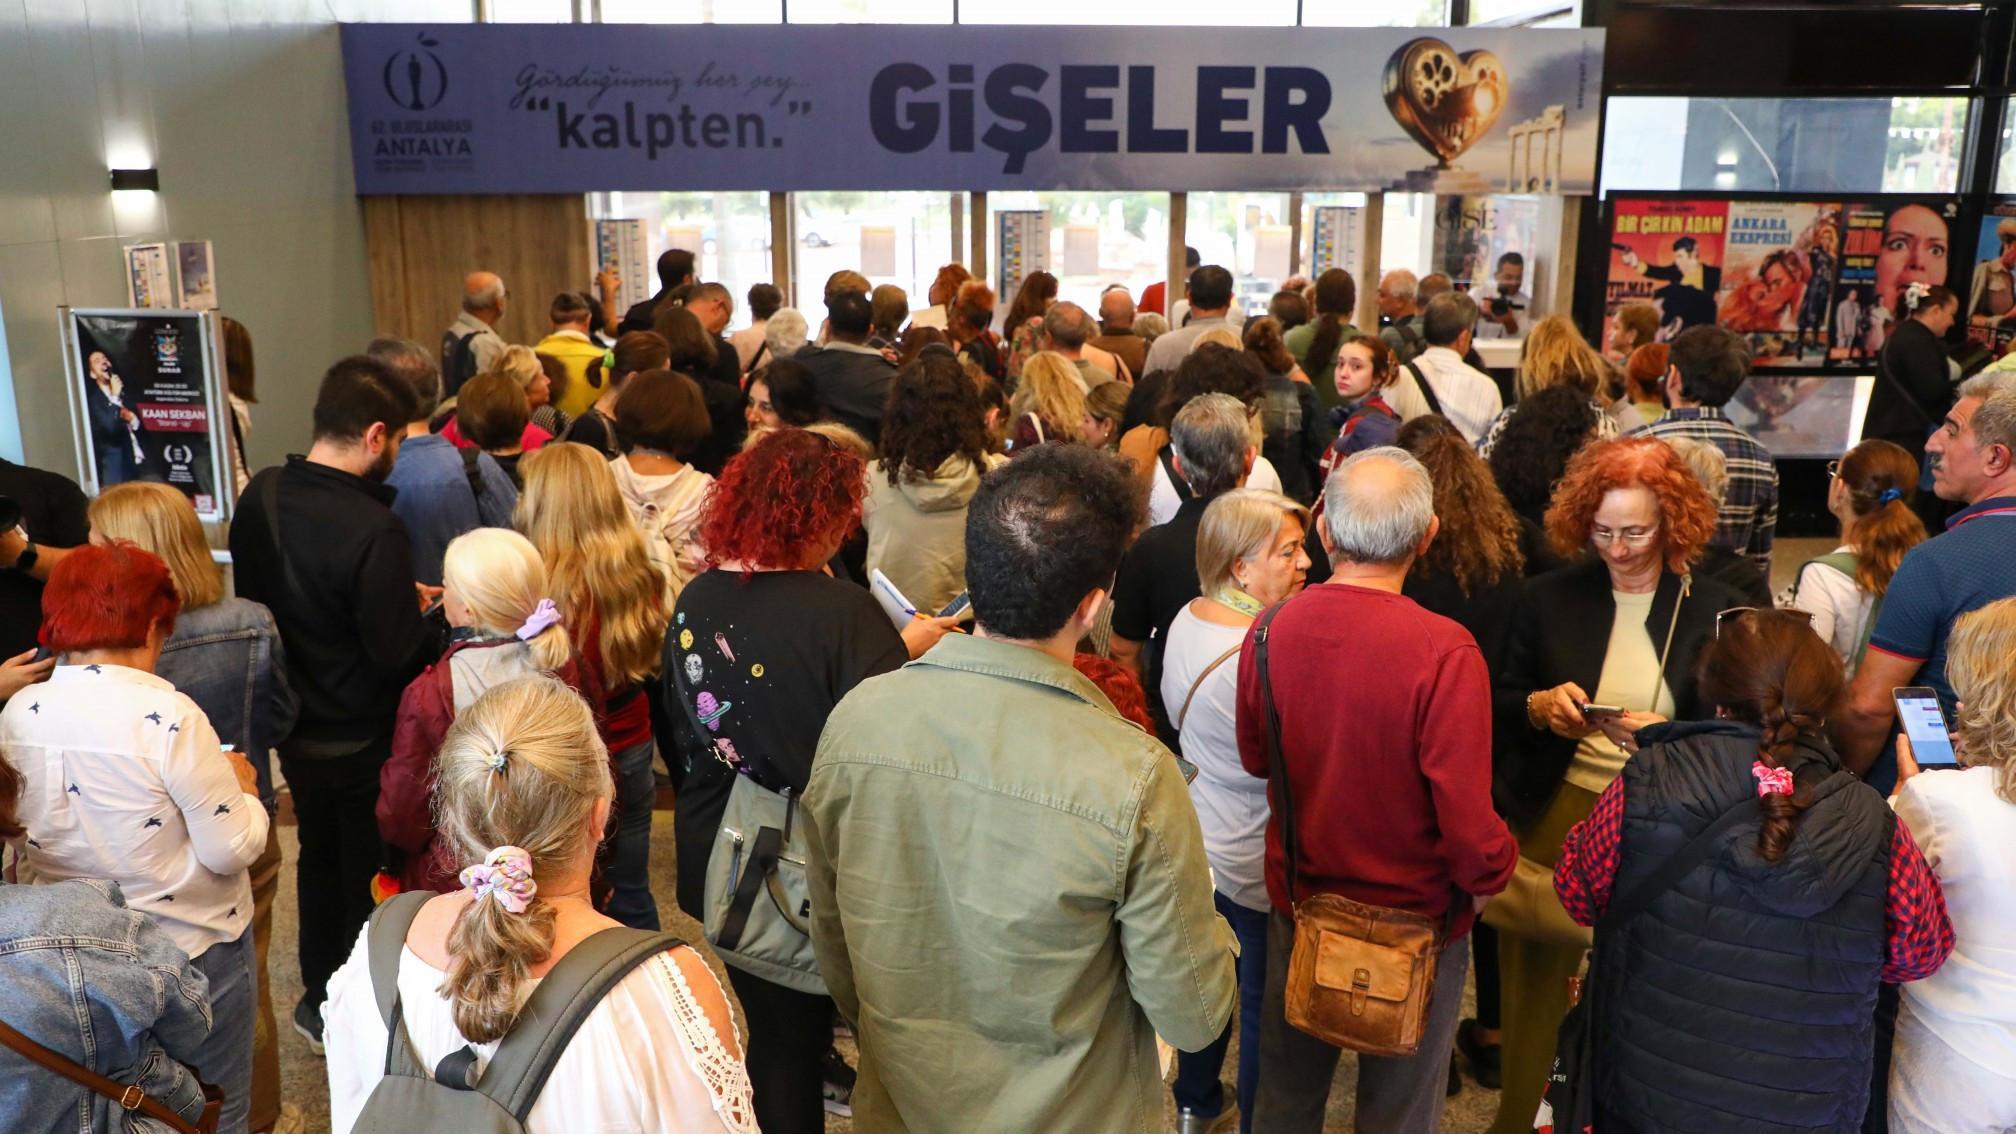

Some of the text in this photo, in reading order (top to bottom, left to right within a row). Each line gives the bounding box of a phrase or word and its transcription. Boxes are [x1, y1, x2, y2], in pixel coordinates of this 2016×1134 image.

[509, 63, 684, 110] Gördüğümüz
[696, 61, 739, 88] her
[375, 137, 473, 156] ANTALYA
[1686, 216, 1724, 234] ADAM
[1732, 217, 1787, 231] ANKARA
[142, 408, 168, 419] KAAN
